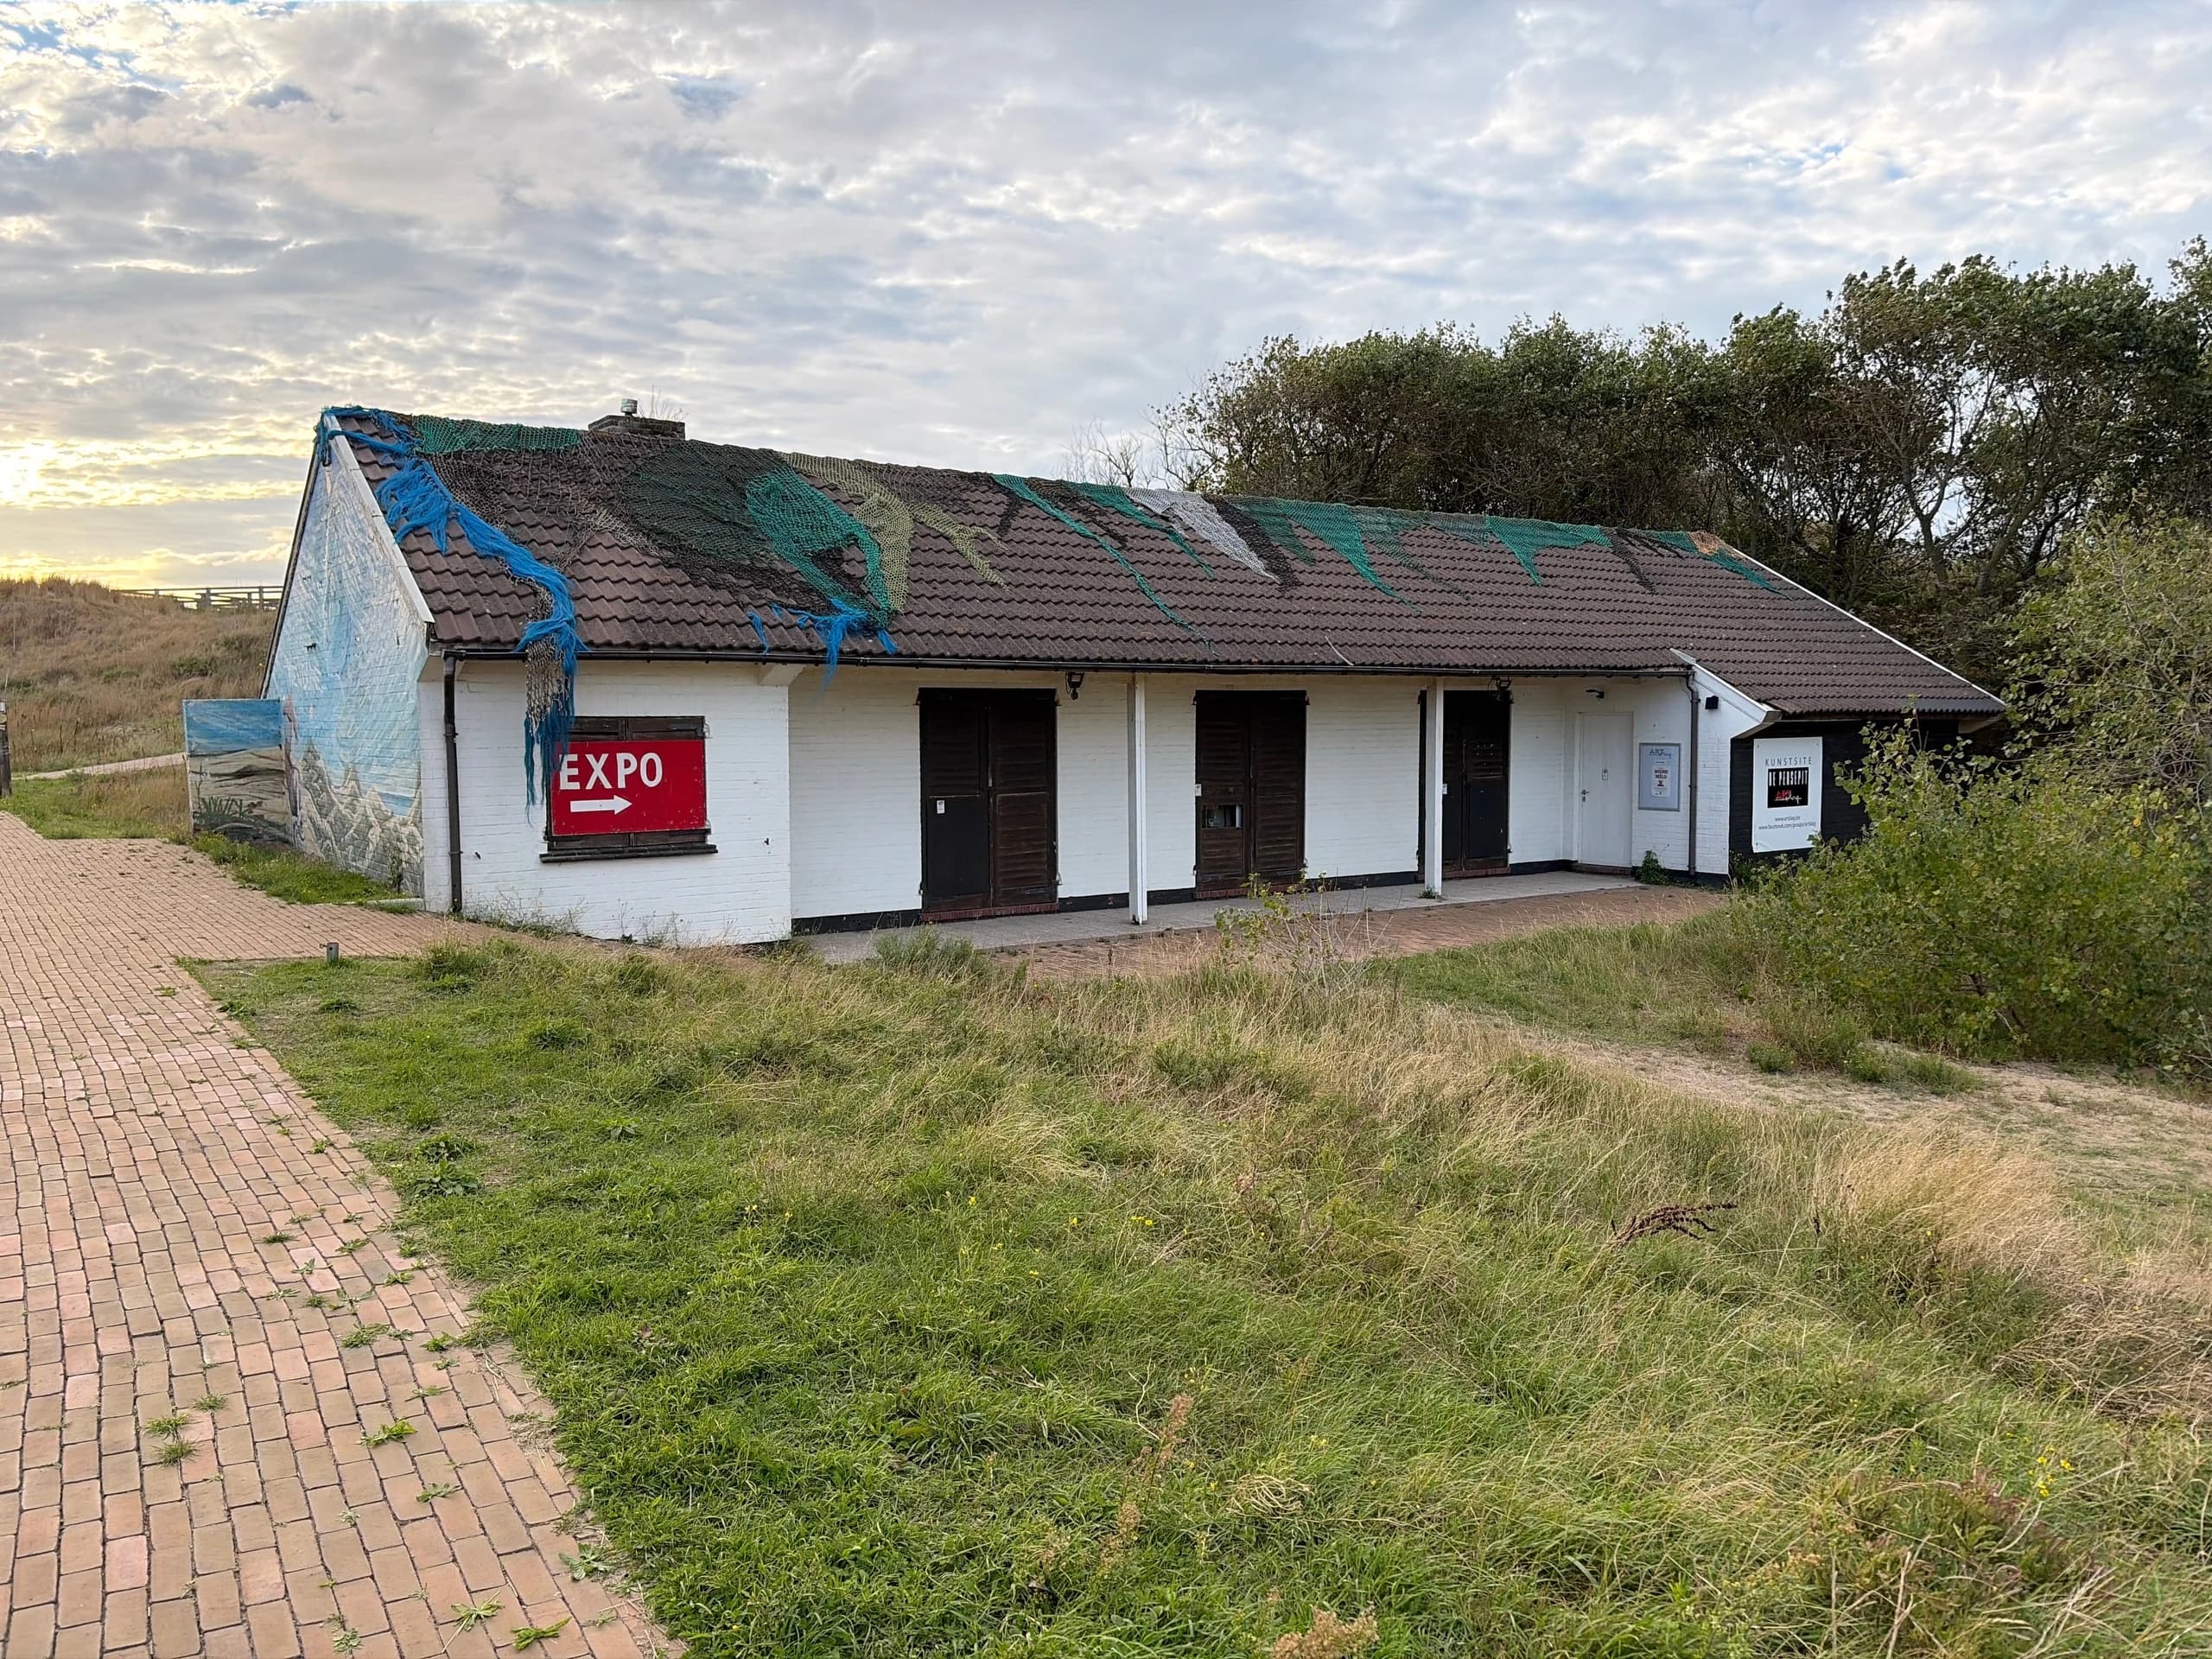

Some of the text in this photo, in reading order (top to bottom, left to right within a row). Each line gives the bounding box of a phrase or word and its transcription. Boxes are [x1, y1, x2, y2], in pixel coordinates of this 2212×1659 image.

[1764, 756, 1812, 766] KUNSTSITE
[559, 752, 663, 790] EXPO
[1769, 771, 1776, 786] DE
